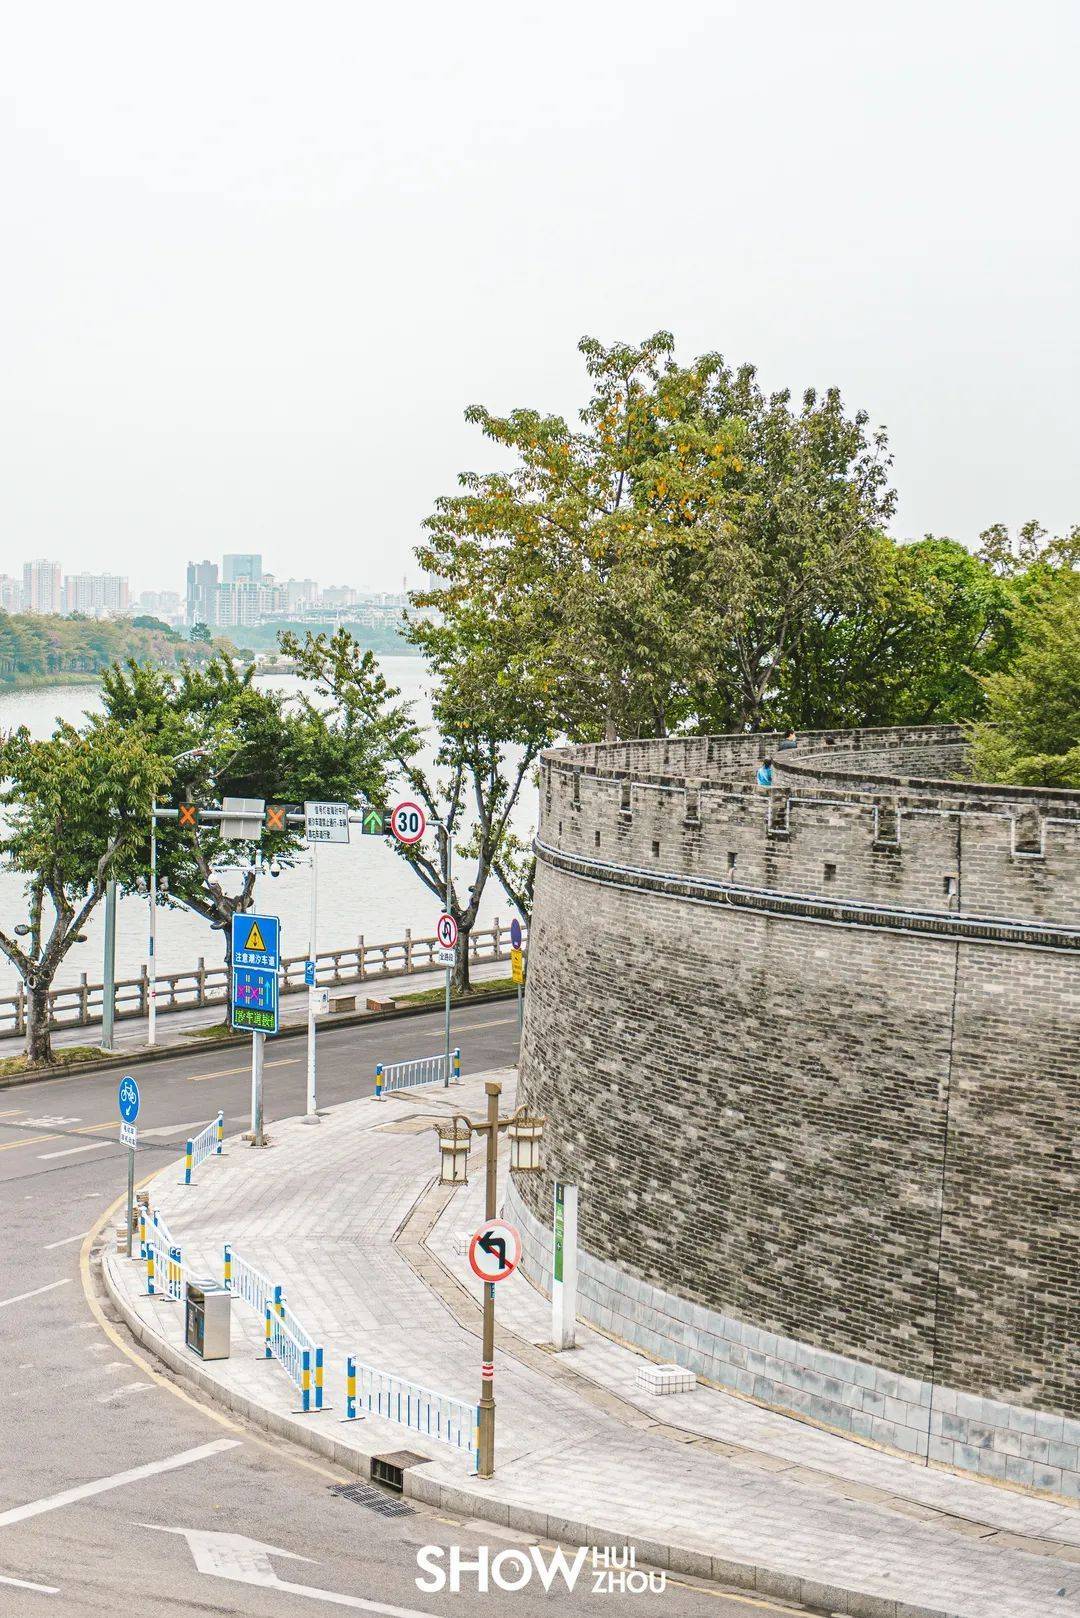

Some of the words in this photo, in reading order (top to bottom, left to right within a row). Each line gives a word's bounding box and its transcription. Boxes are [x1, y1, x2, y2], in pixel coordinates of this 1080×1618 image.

[398, 811, 419, 833] 30
[235, 951, 275, 967] 注意潮汐车道
[439, 952, 454, 962] 全路段
